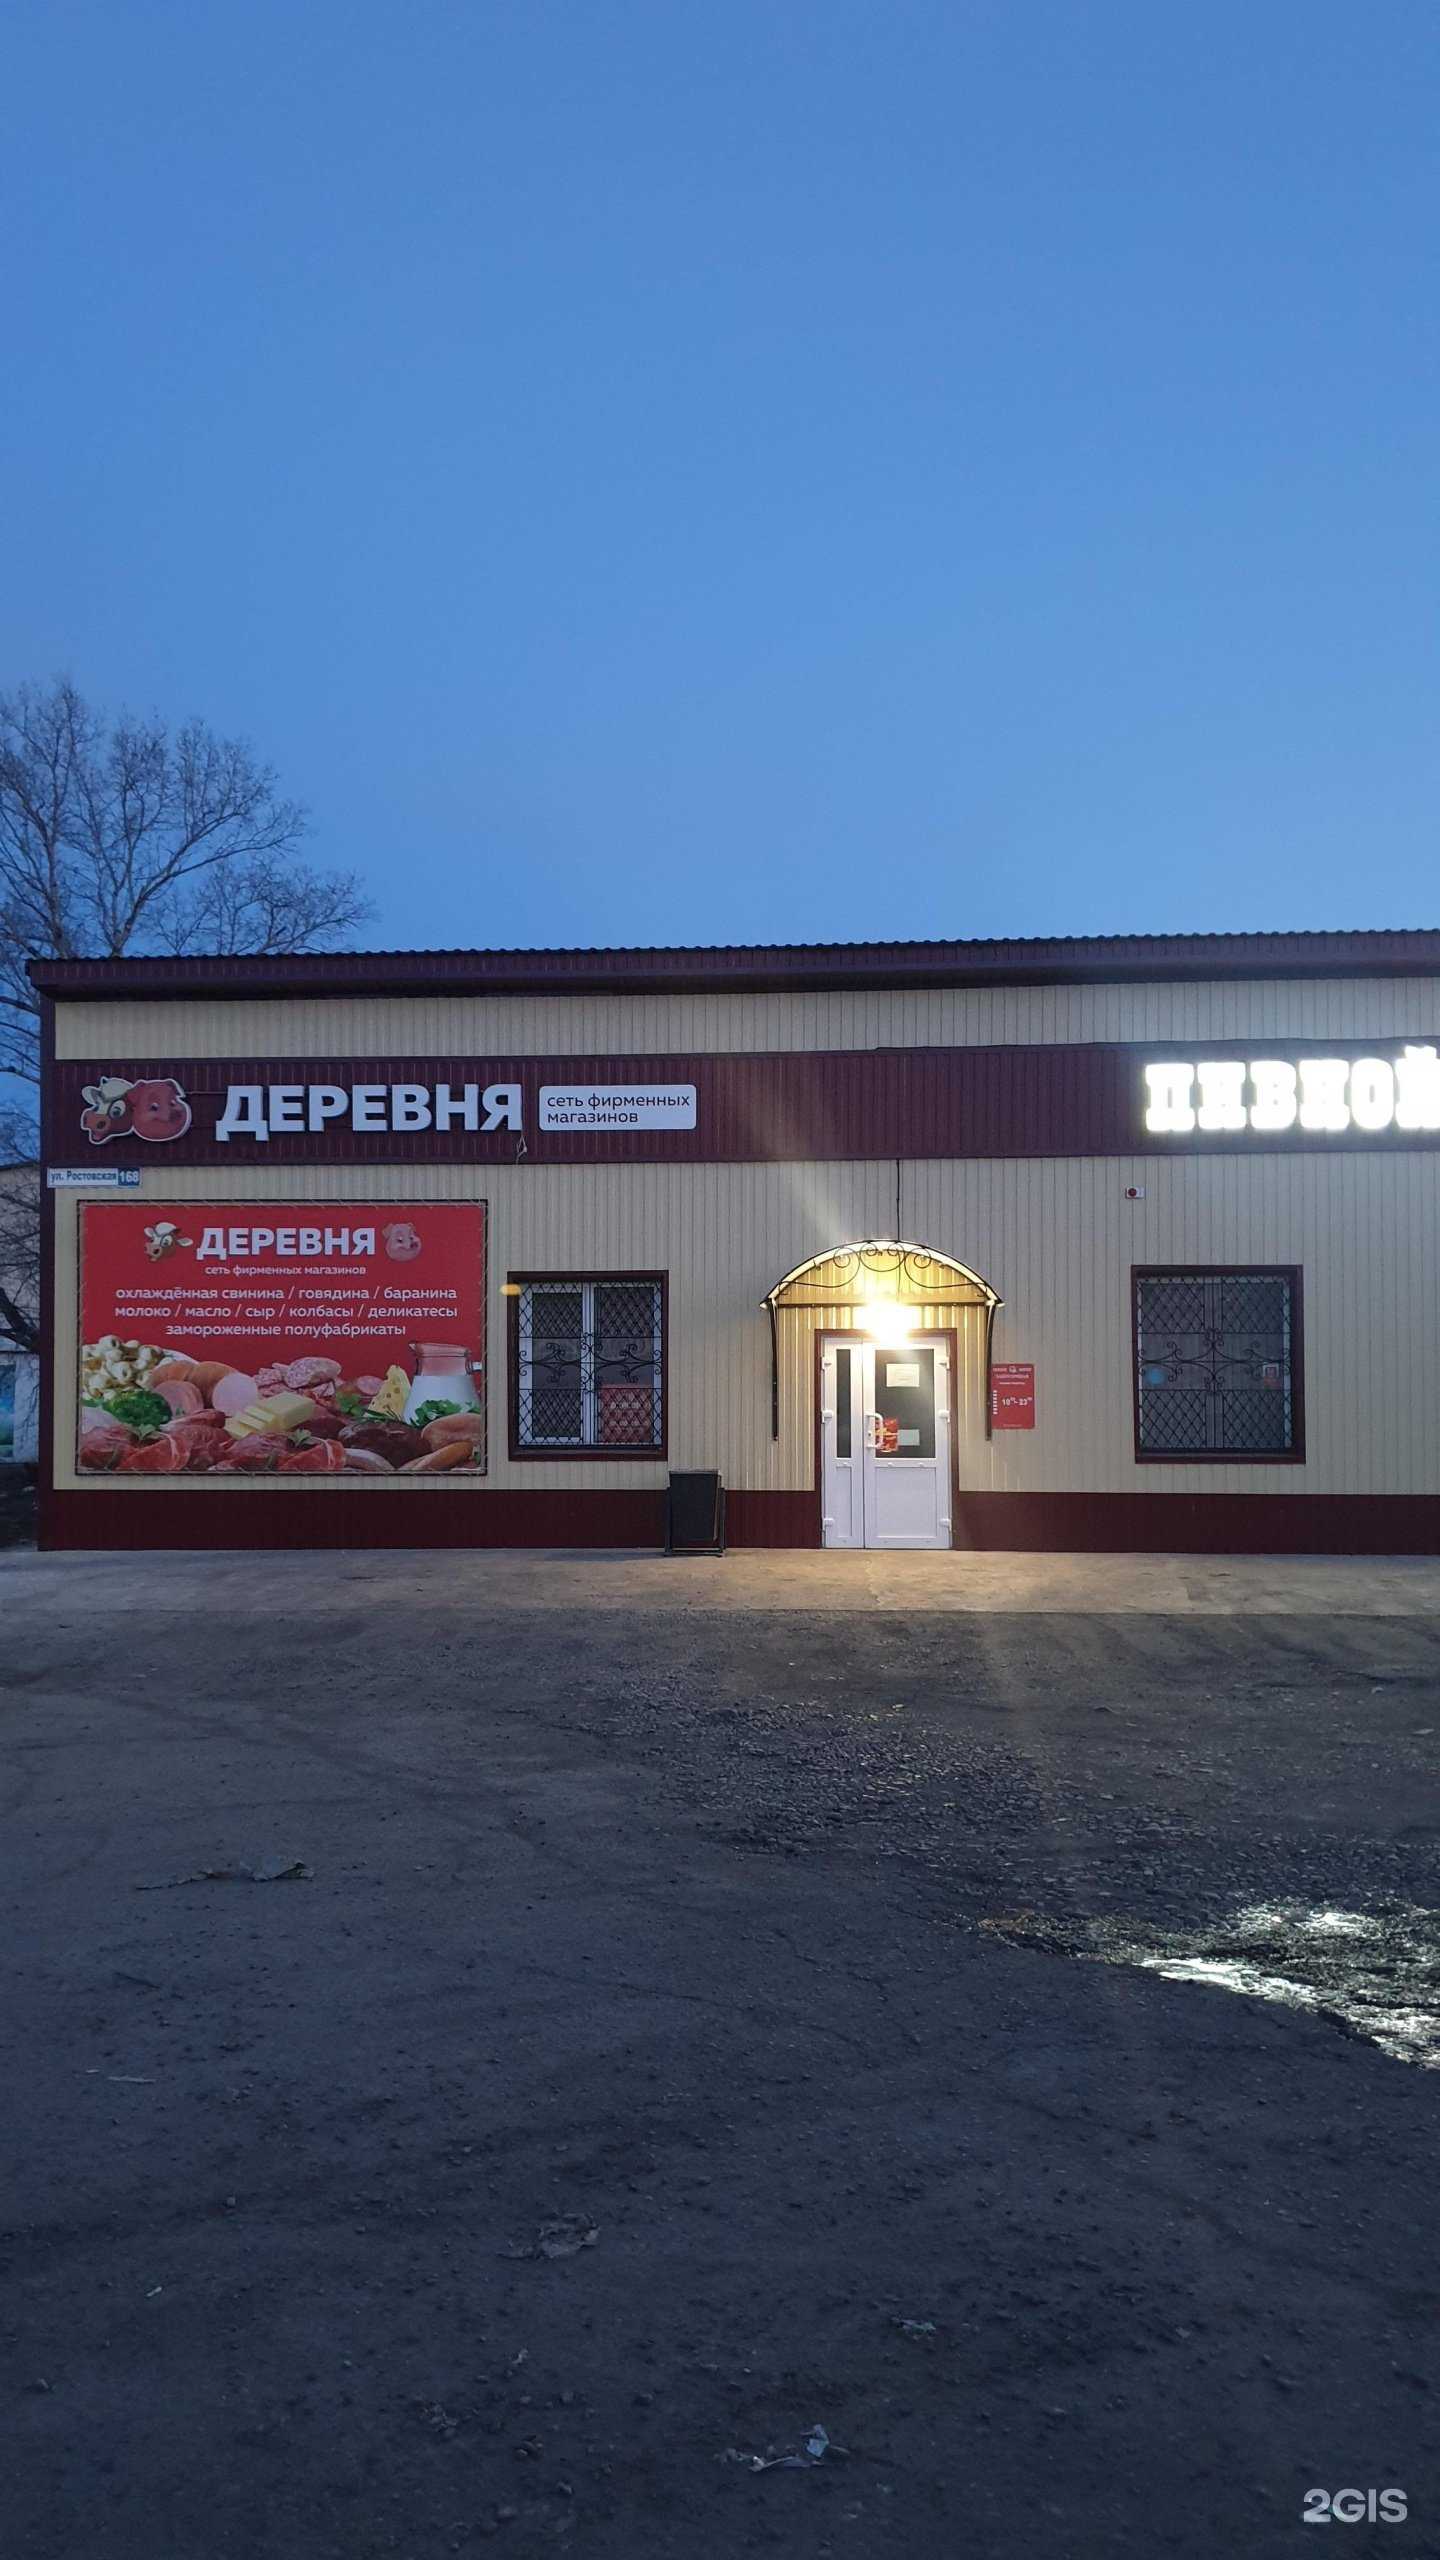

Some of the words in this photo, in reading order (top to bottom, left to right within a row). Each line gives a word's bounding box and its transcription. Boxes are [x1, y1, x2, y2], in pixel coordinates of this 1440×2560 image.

[547, 1096, 583, 1107] сеть
[588, 1093, 690, 1110] фирменных
[215, 1083, 523, 1142] ДЕРЕВНЯ
[547, 1112, 638, 1123] магазинов
[67, 1170, 117, 1181] Ростовская
[119, 1170, 139, 1182] 168
[196, 1227, 376, 1260] ДЕРЕВНЯ
[233, 1265, 302, 1276] фирменных
[304, 1266, 366, 1275] магазинов
[115, 1287, 218, 1300] охлаждённая
[221, 1289, 284, 1299] свинина
[298, 1289, 369, 1300] говядина
[384, 1286, 457, 1301] баранина
[115, 1307, 172, 1317] молоко
[185, 1307, 231, 1317] масло
[245, 1307, 275, 1320] сыр
[289, 1305, 354, 1317] колбасы
[368, 1307, 458, 1318] деликатесы
[166, 1325, 281, 1338] замороженные
[285, 1323, 406, 1338] полуфабрикаты
